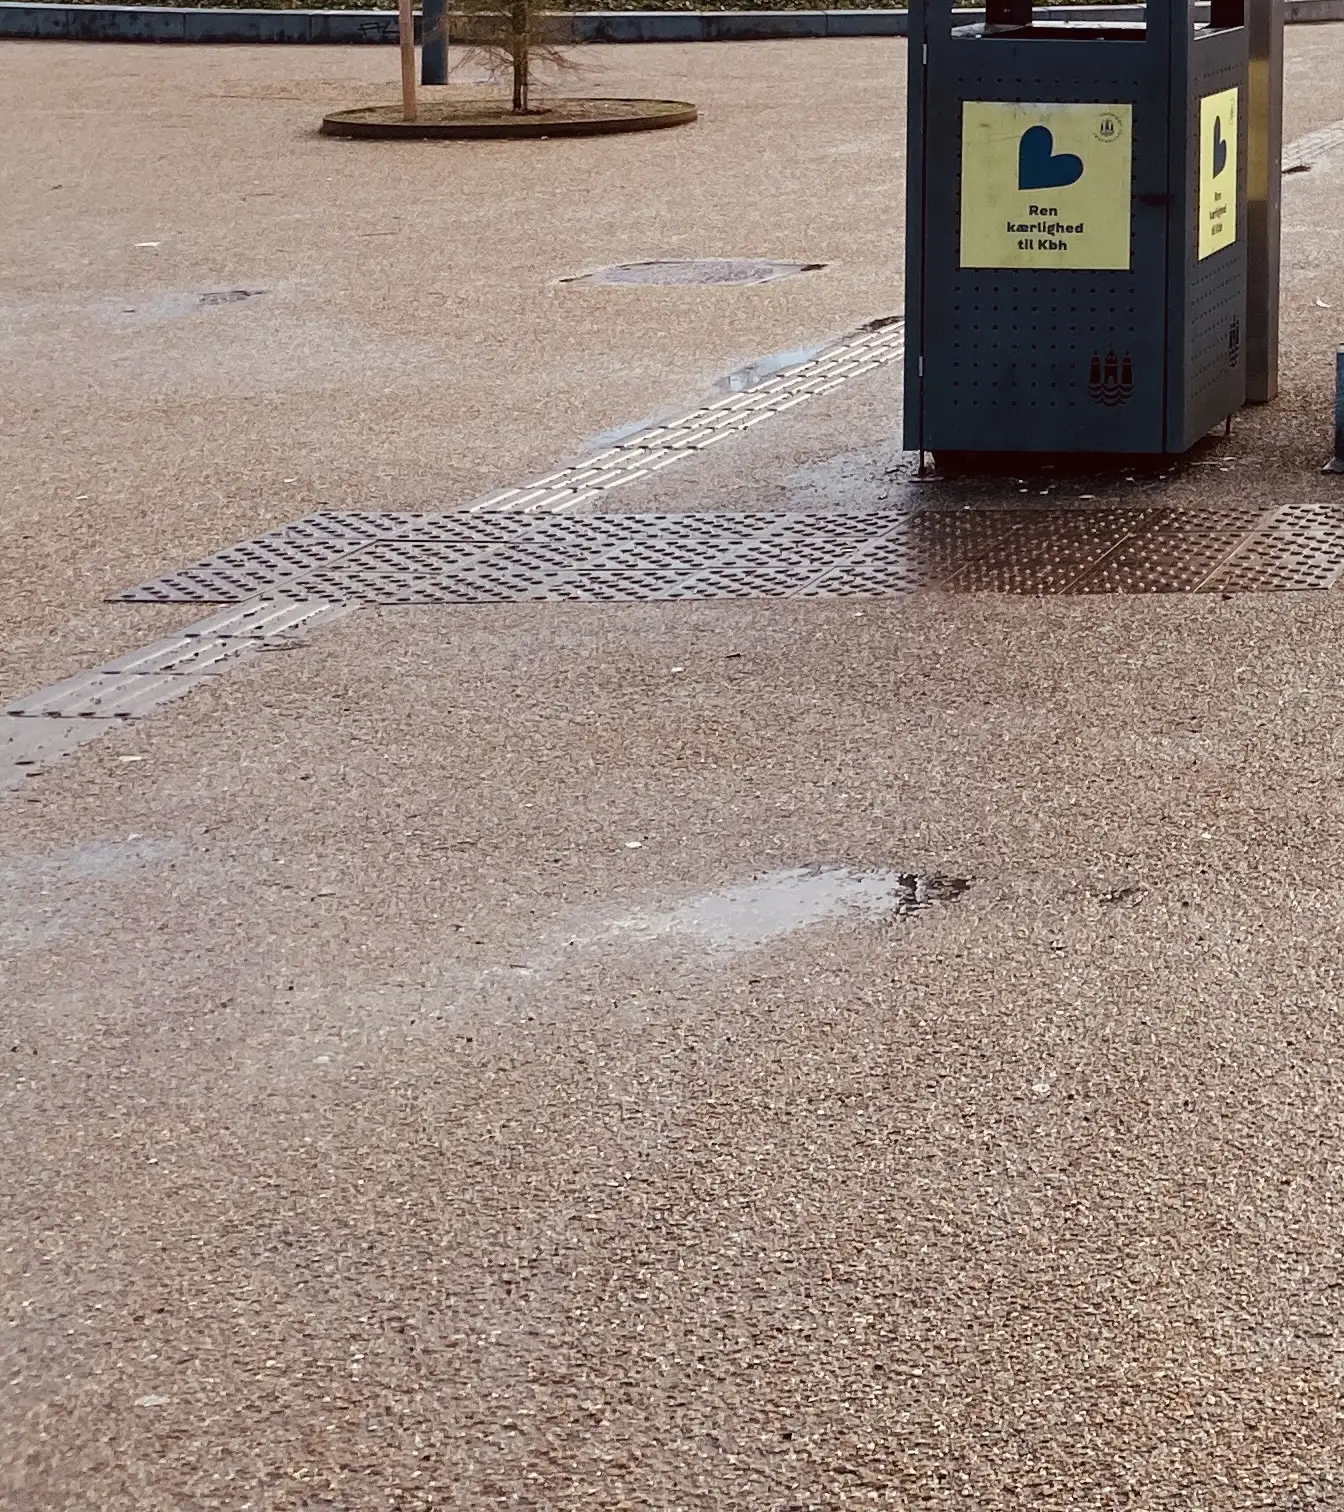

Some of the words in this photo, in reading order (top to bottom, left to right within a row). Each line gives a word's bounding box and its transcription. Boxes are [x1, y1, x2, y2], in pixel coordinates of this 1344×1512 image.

[1028, 204, 1058, 216] Ren
[1006, 221, 1084, 237] kærlighed
[1018, 238, 1033, 250] til
[1037, 239, 1068, 251] Kbh
